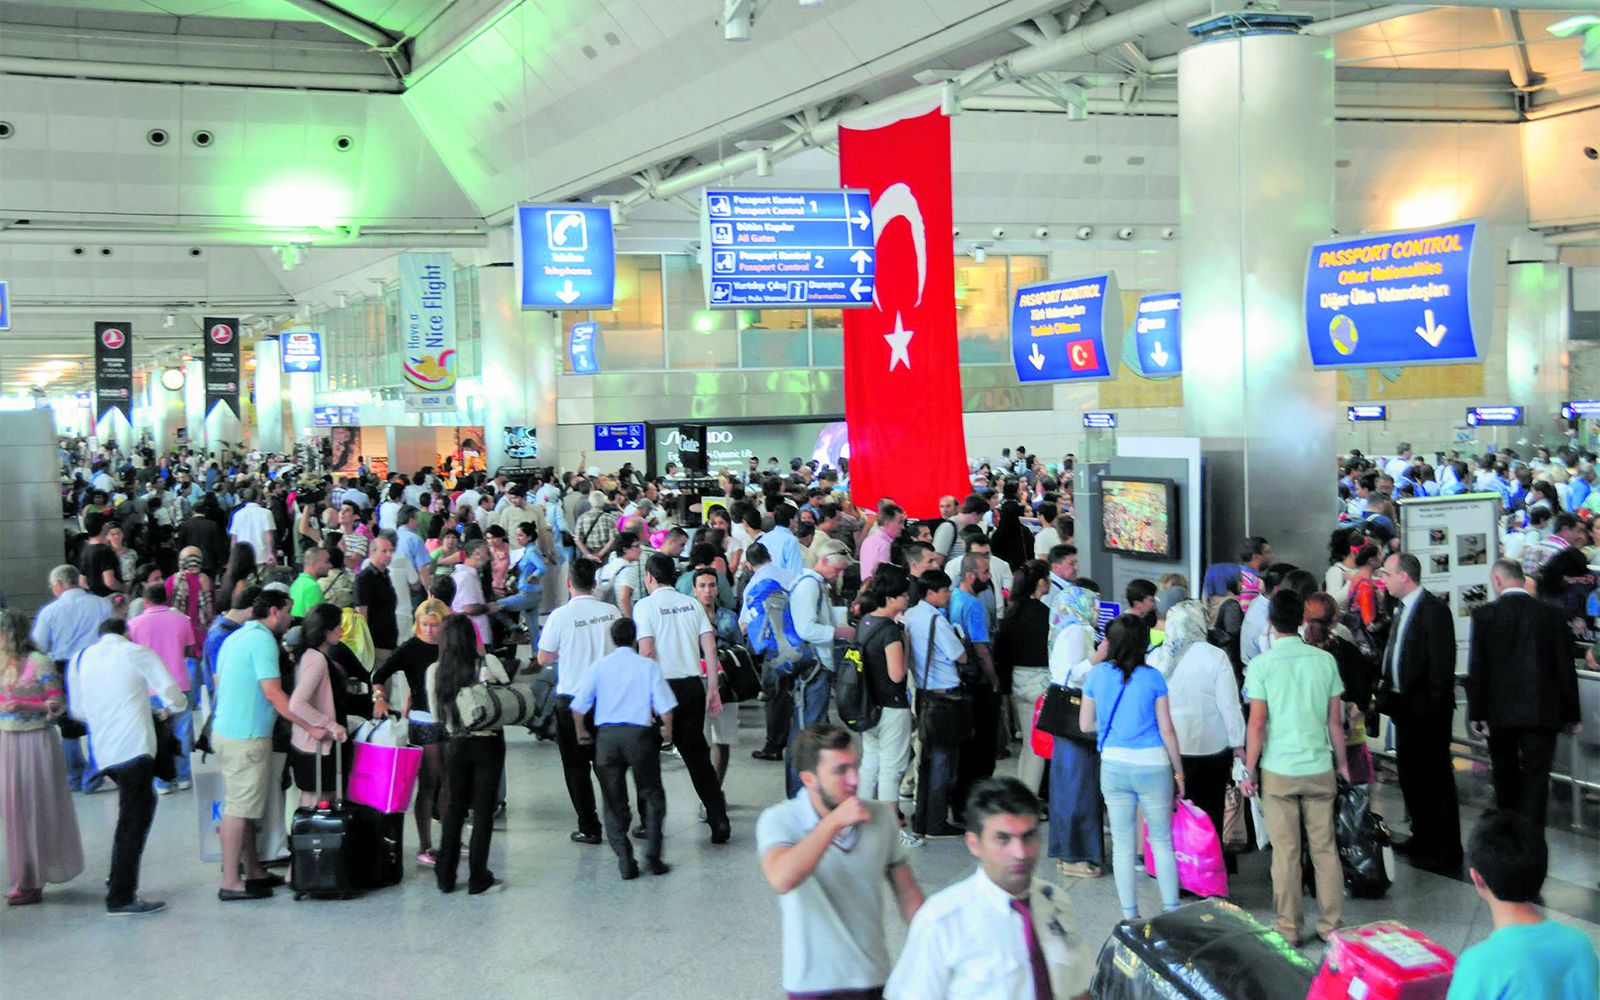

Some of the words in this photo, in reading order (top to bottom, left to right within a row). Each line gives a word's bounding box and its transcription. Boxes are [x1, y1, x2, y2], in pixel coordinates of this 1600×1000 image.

[772, 206, 805, 215] Control
[809, 200, 818, 213] 1
[738, 234, 749, 242] All
[751, 234, 776, 242] Gates
[1318, 243, 1391, 268] PASSPORT
[1391, 234, 1464, 259] CONTROL
[777, 263, 810, 271] Control
[814, 255, 825, 269] 2
[1338, 270, 1370, 285] Other
[1371, 261, 1443, 282] Nationalities
[420, 264, 447, 309] Flight
[408, 324, 420, 349] Have
[425, 315, 444, 348] Nice
[616, 438, 623, 448] 1
